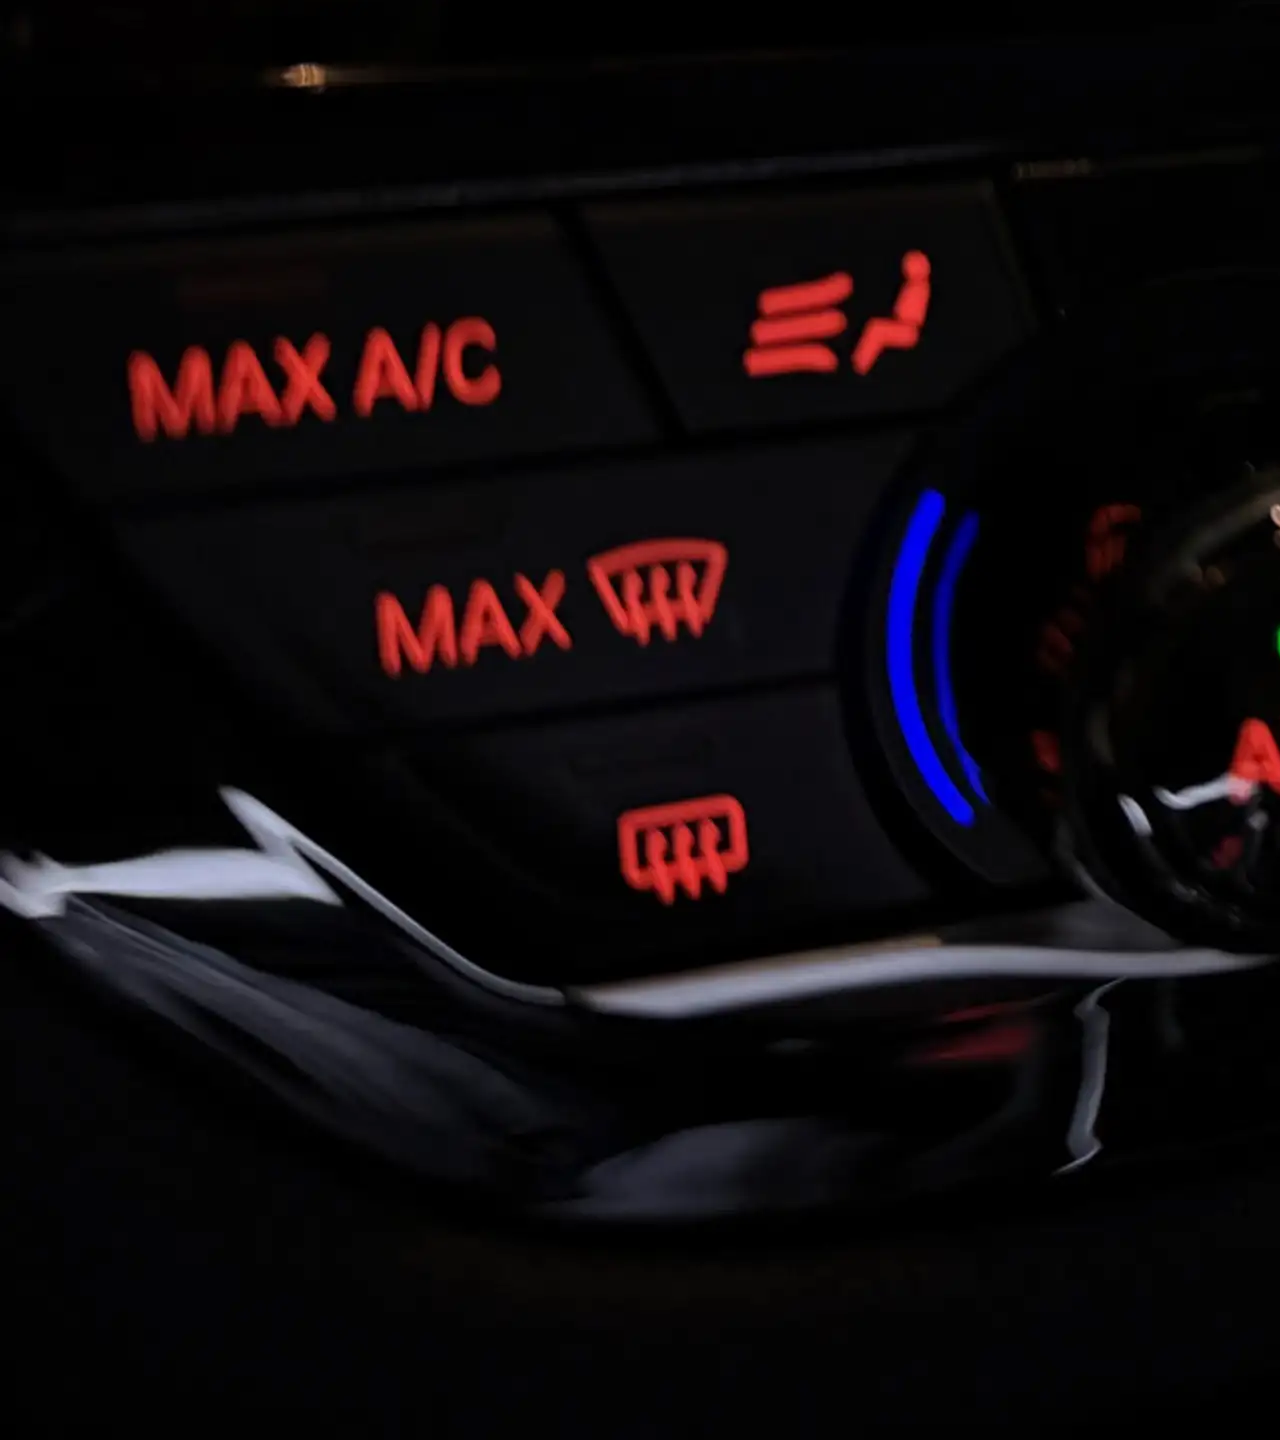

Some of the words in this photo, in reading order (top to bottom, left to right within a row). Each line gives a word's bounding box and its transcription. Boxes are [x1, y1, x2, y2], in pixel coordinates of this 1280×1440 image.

[125, 330, 339, 442] MAX
[351, 313, 504, 420] A/C
[372, 566, 575, 679] MAX
